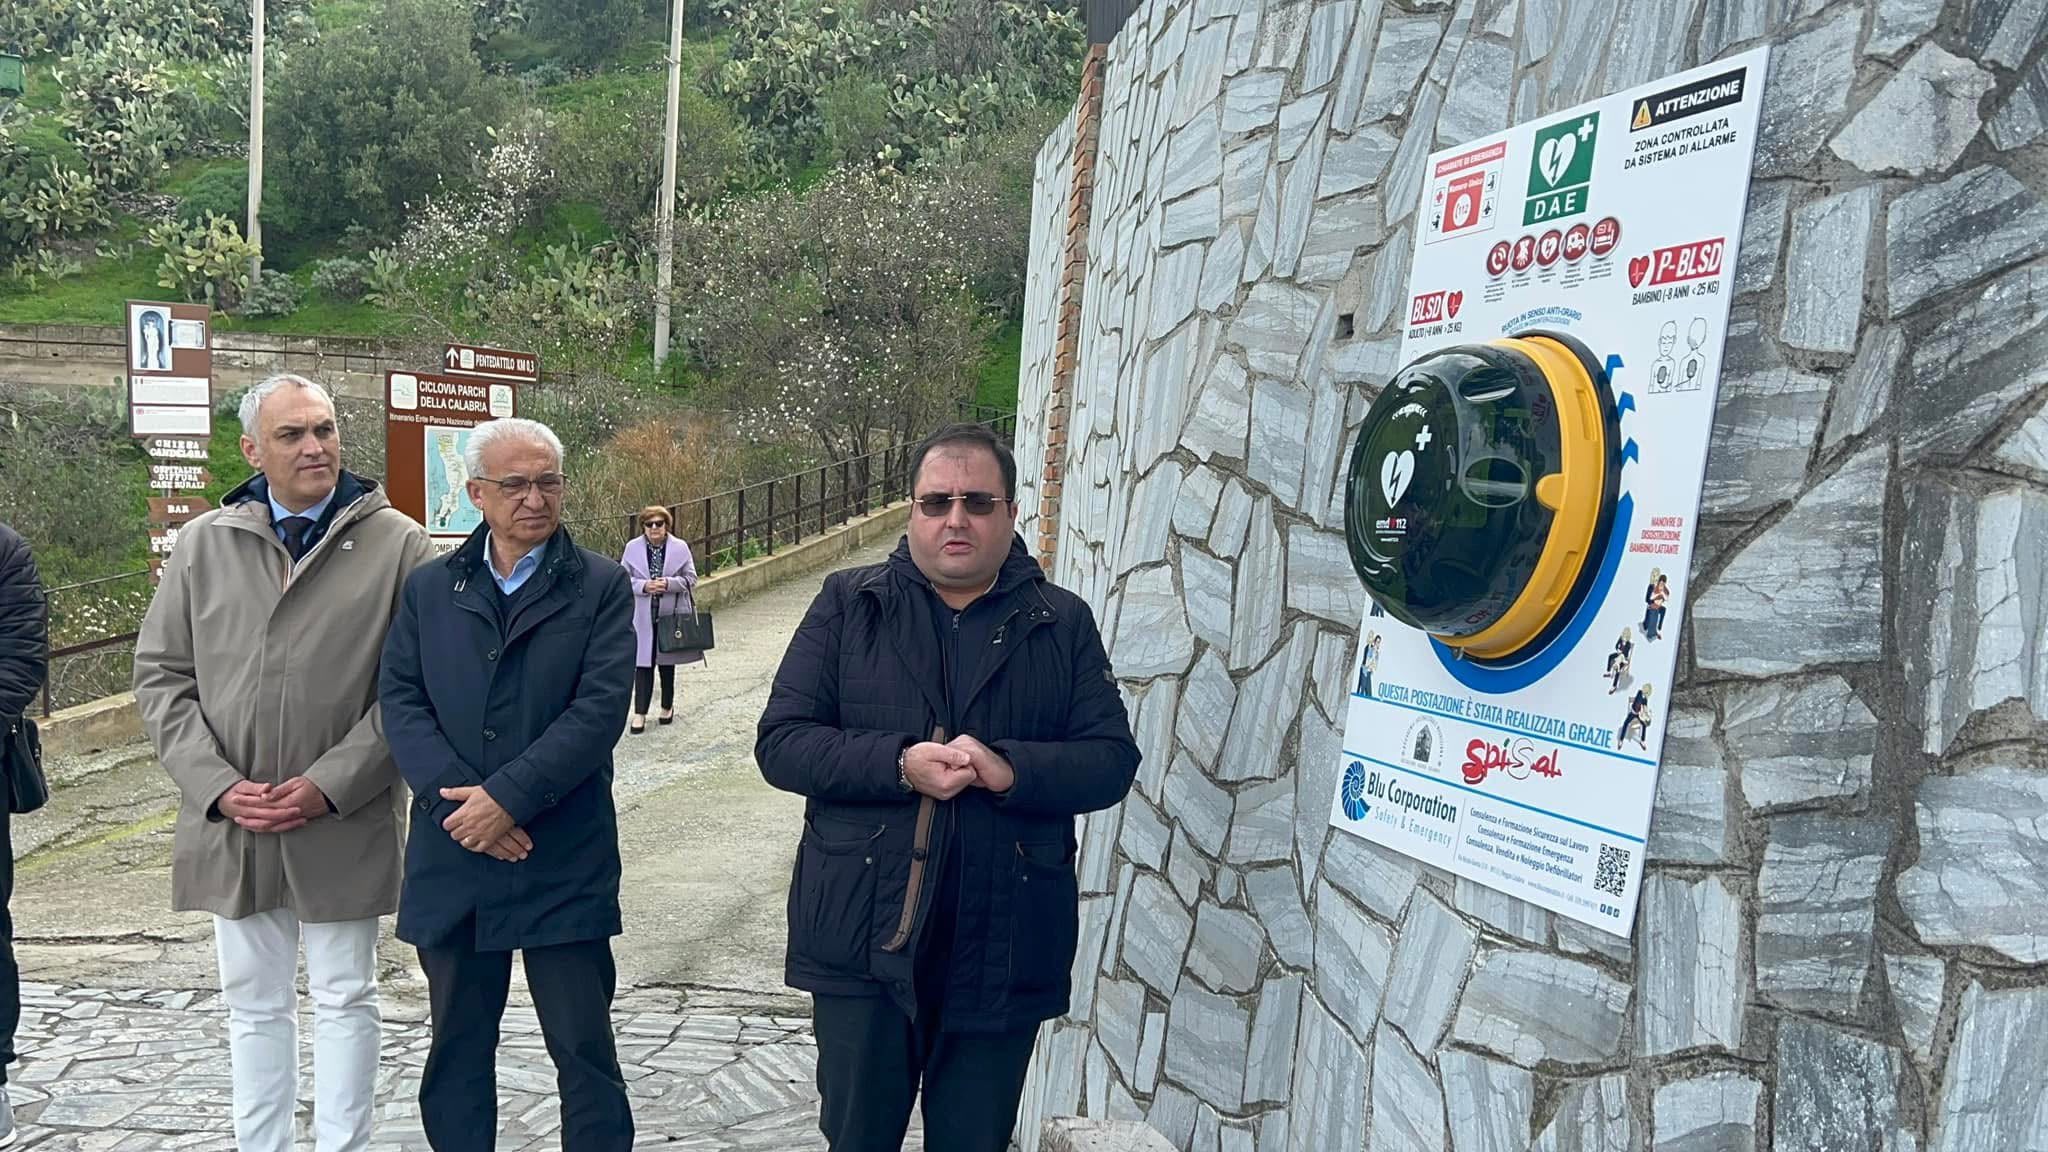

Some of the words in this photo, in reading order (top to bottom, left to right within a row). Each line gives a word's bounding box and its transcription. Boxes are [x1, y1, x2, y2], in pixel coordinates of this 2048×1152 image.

[1655, 80, 1740, 116] ATTENZIONE
[1634, 137, 1659, 152] ZONA
[1661, 118, 1729, 145] CONTROLLATA
[1624, 158, 1637, 169] DA
[1638, 147, 1677, 166] SISTEMA
[1679, 144, 1689, 156] DI
[1690, 131, 1737, 153] ALLARME
[1534, 192, 1577, 220] DAE
[1656, 242, 1722, 282] P-BLSD
[1632, 289, 1662, 306] BAMBINO
[1673, 285, 1690, 300] ANNI
[1707, 280, 1720, 295] KG)
[1412, 295, 1442, 321] BLSD
[1520, 311, 1527, 321] IN
[1527, 307, 1546, 319] SENSO
[475, 353, 515, 370] PENTEDATTILO
[516, 359, 526, 371] KM
[419, 380, 456, 393] CICLOVIA
[458, 385, 487, 398] PARCHI
[420, 396, 447, 408] DELLA
[448, 398, 488, 413] CALABRIA
[429, 415, 446, 425] Parco
[155, 439, 200, 450] CHIESA
[167, 505, 189, 514] BAR
[1378, 682, 1409, 702] QUESTA
[1410, 689, 1466, 716] POSTAZIONE
[1473, 702, 1503, 725] STATA
[1505, 708, 1566, 740] REALIZZATA
[1568, 723, 1614, 749] GRAZIE
[1367, 771, 1386, 799] Blu
[1387, 778, 1457, 824] Corporation
[1374, 806, 1398, 829] Safety
[1408, 818, 1452, 849] Emergency
[1470, 807, 1498, 824] Consulenza
[1502, 817, 1533, 835] Formazione
[1533, 826, 1559, 844] Sicurezza
[1568, 838, 1590, 854] Lavoro
[1477, 824, 1506, 842] Consulenza
[1510, 835, 1542, 853] Formazione
[1542, 845, 1574, 865] Emergenza
[1520, 854, 1545, 872] Noleggio
